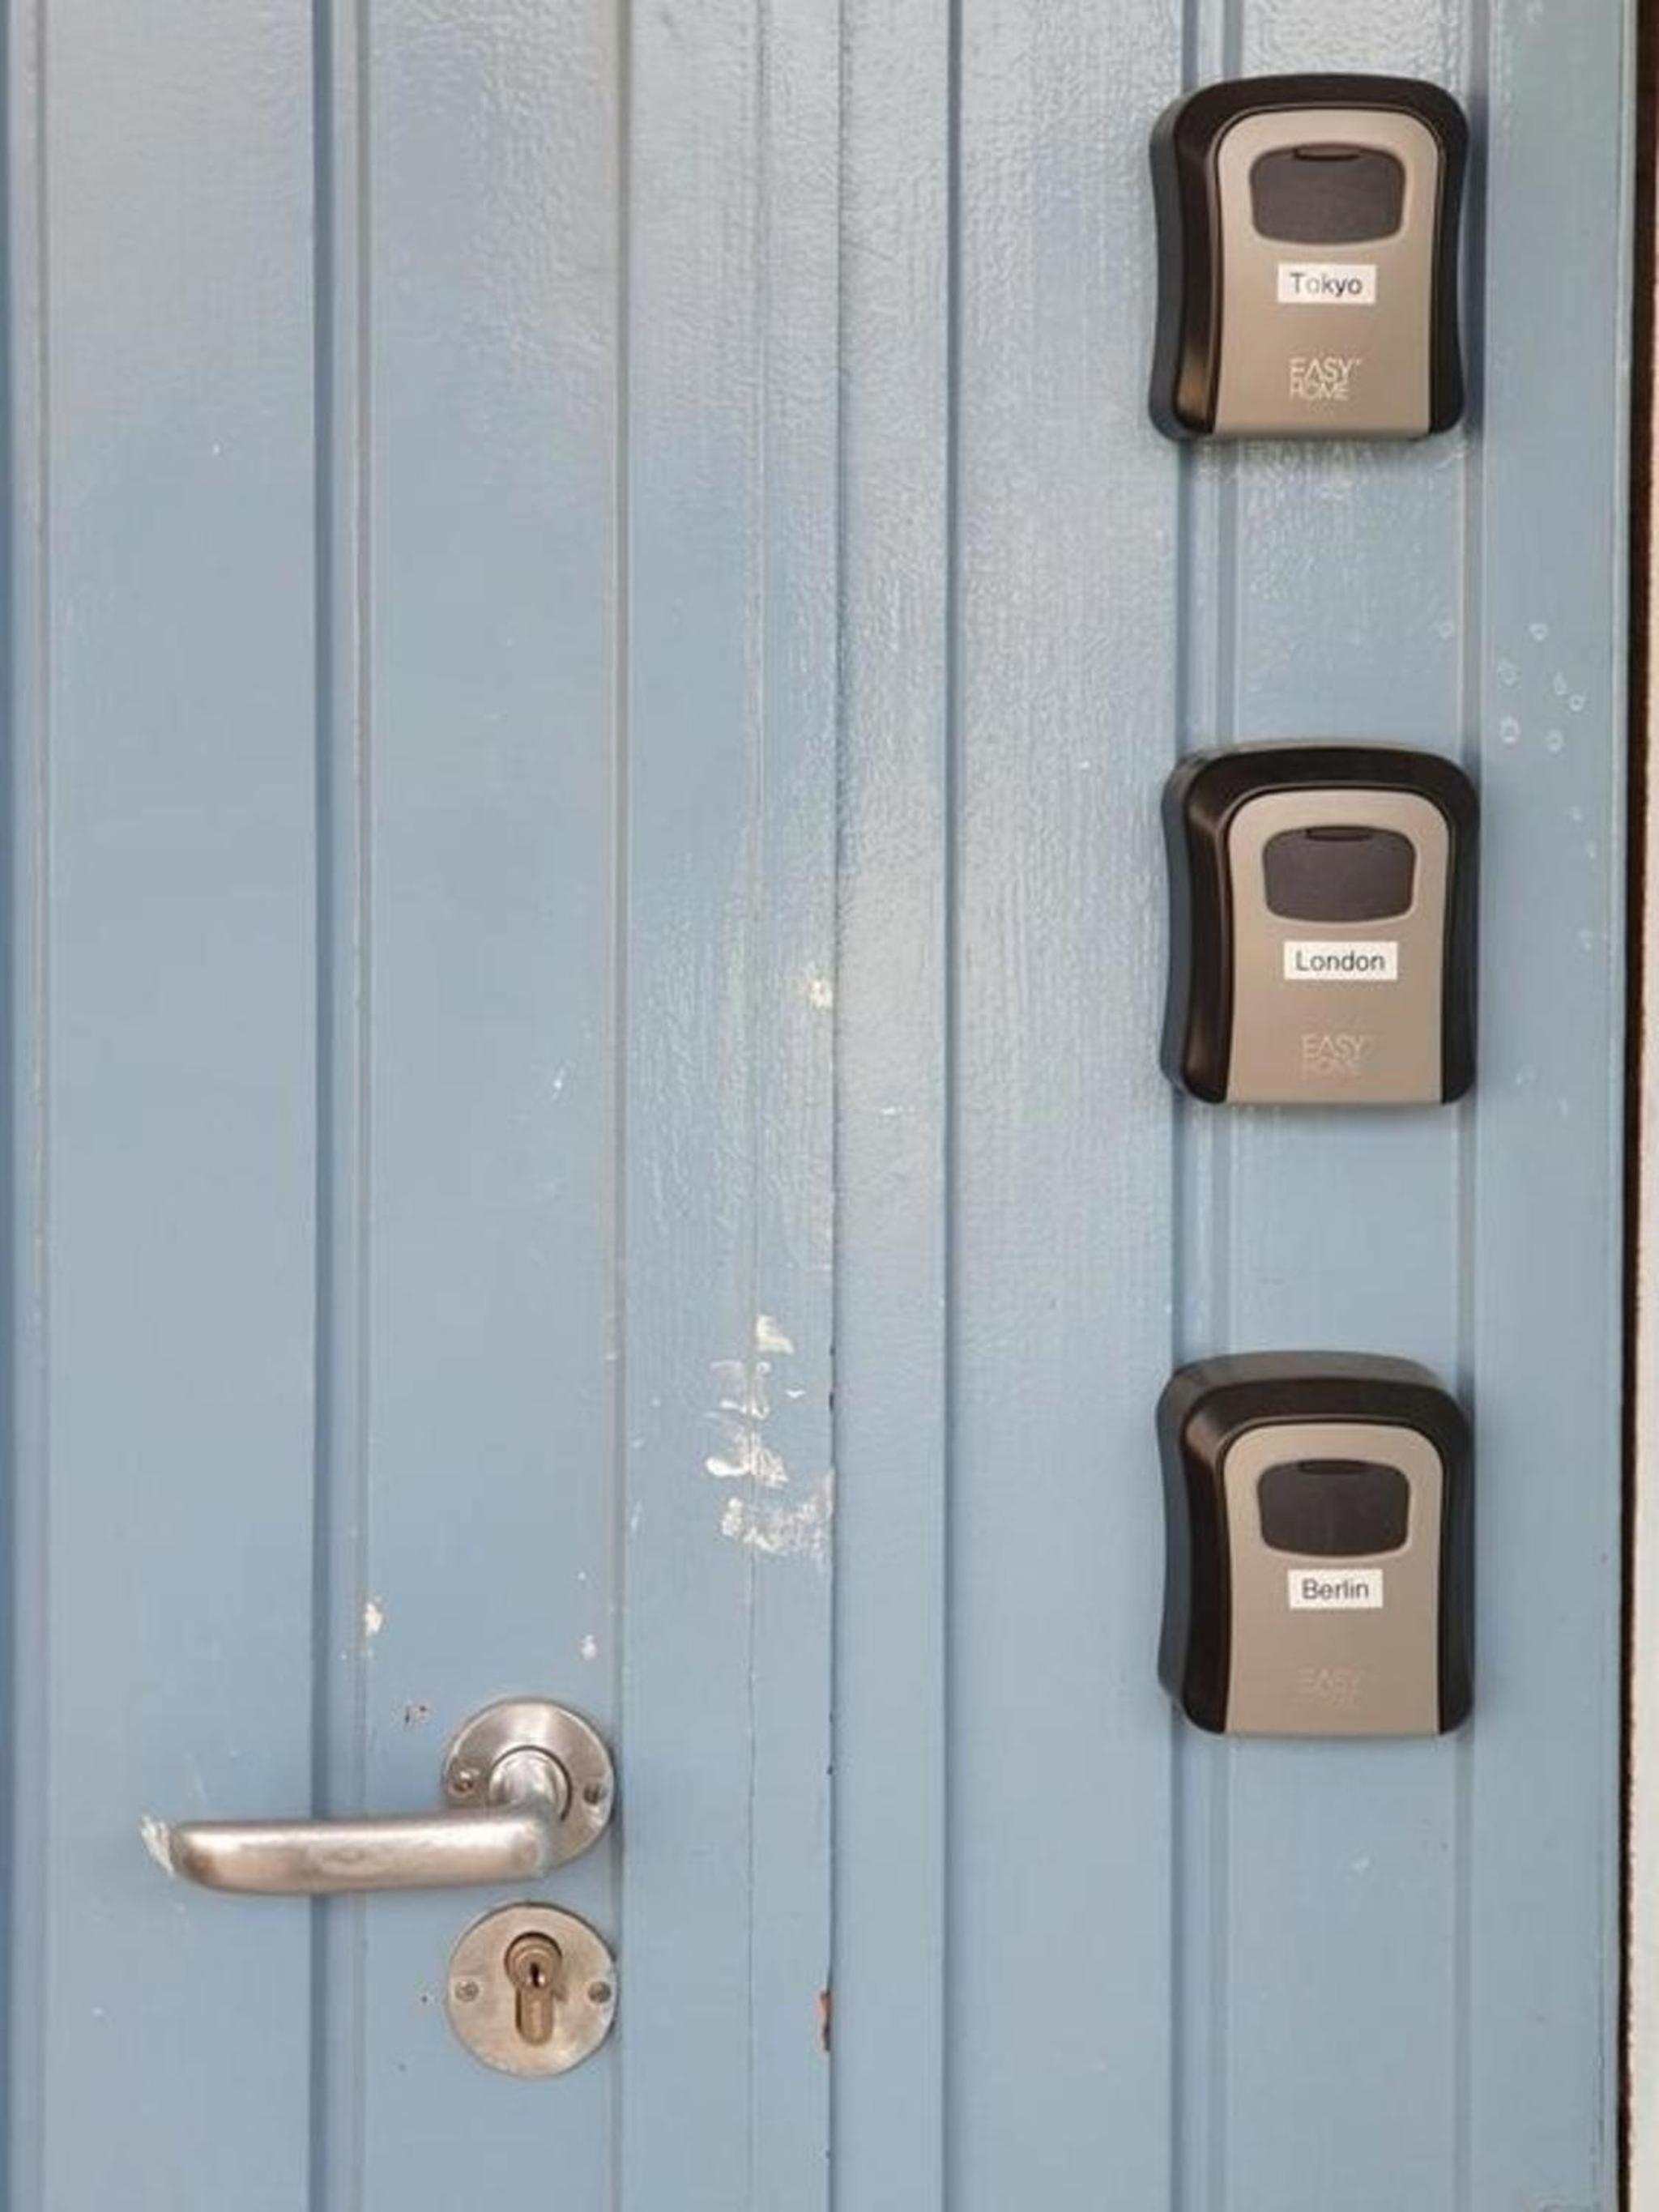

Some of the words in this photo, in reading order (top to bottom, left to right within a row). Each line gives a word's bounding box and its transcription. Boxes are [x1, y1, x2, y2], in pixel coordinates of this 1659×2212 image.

[1290, 271, 1363, 298] Tokyo
[1290, 357, 1354, 380] EASY
[1295, 950, 1385, 973] London
[1301, 1034, 1364, 1059] EASY
[1302, 1579, 1369, 1600] Berlin
